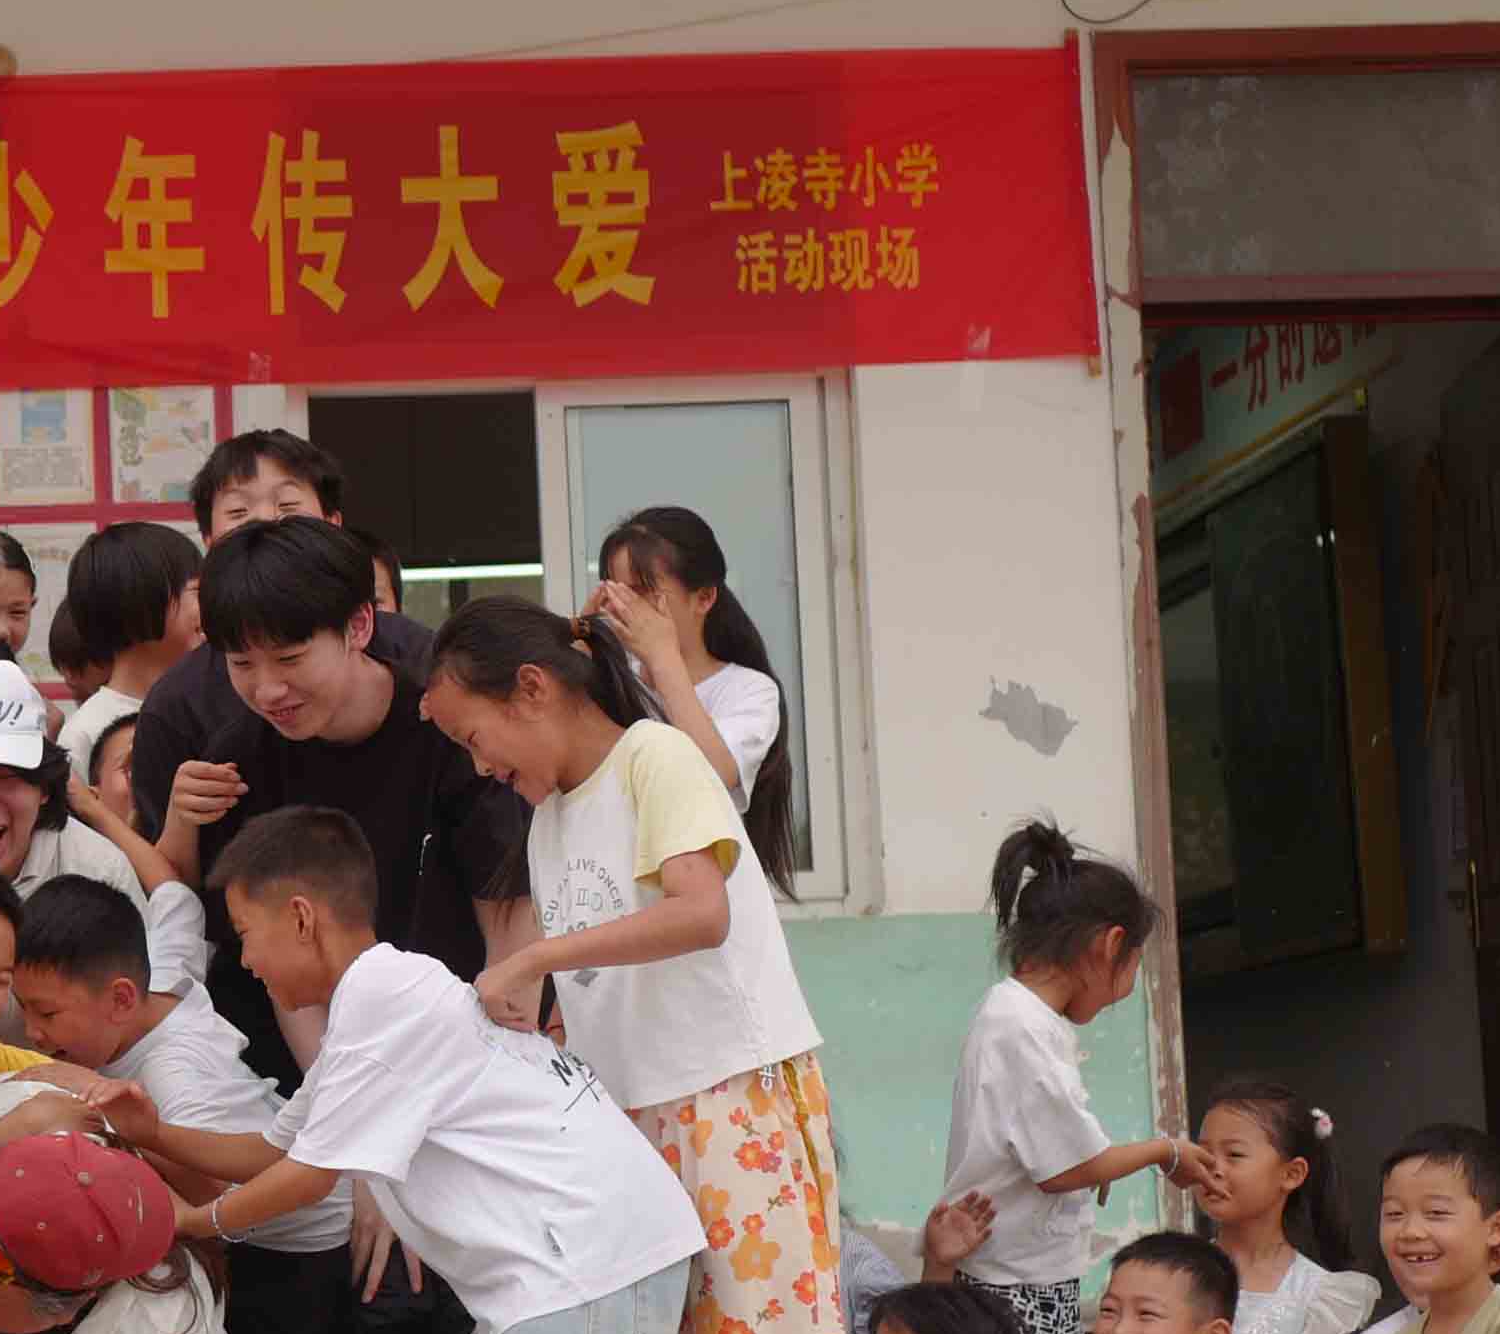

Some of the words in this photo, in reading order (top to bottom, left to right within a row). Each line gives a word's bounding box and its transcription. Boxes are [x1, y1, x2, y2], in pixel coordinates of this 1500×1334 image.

[710, 144, 938, 212] 上凌寺小学
[736, 225, 920, 294] 活动现场
